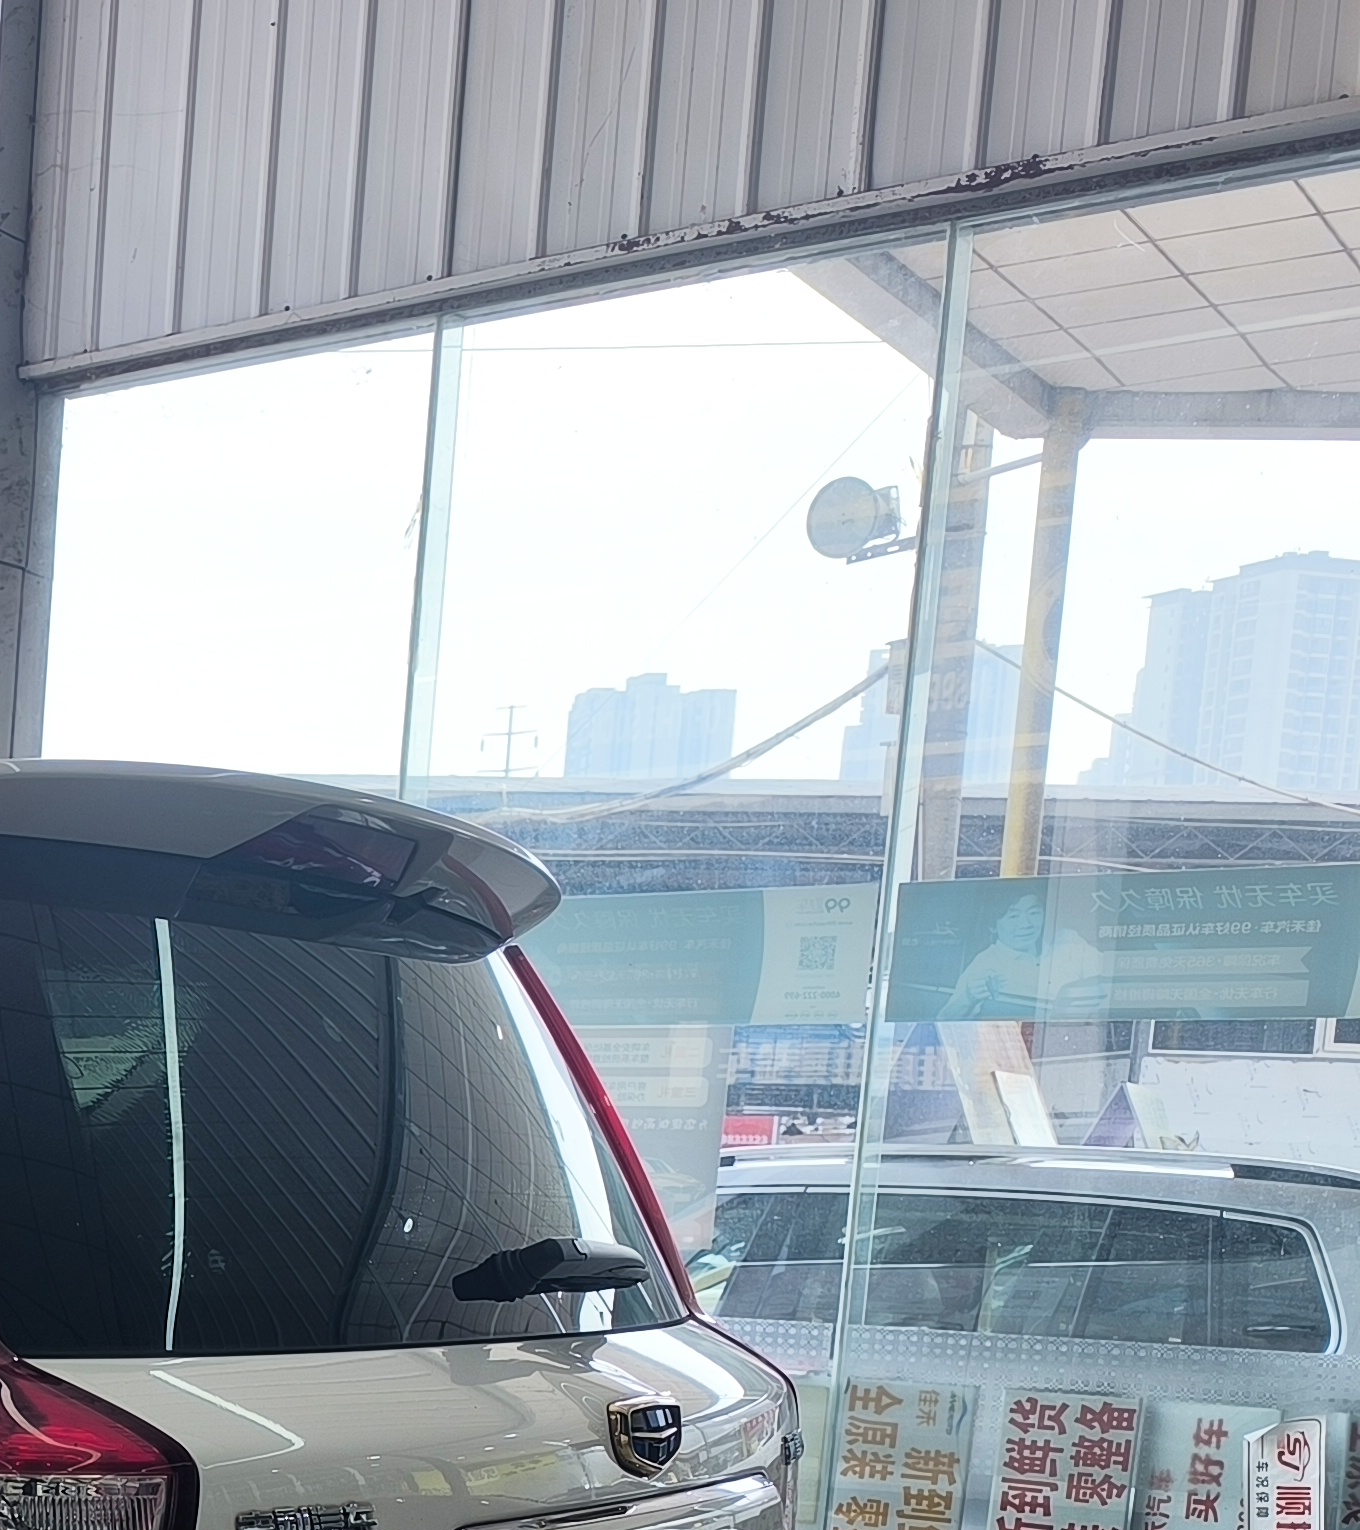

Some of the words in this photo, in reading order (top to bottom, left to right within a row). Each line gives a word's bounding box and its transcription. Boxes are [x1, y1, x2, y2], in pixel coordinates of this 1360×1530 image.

[839, 1382, 904, 1482] 全原装
[916, 1388, 942, 1428] 佳禾
[1066, 1400, 1140, 1507] 零整备
[1255, 1460, 1270, 1518] 车况保障
